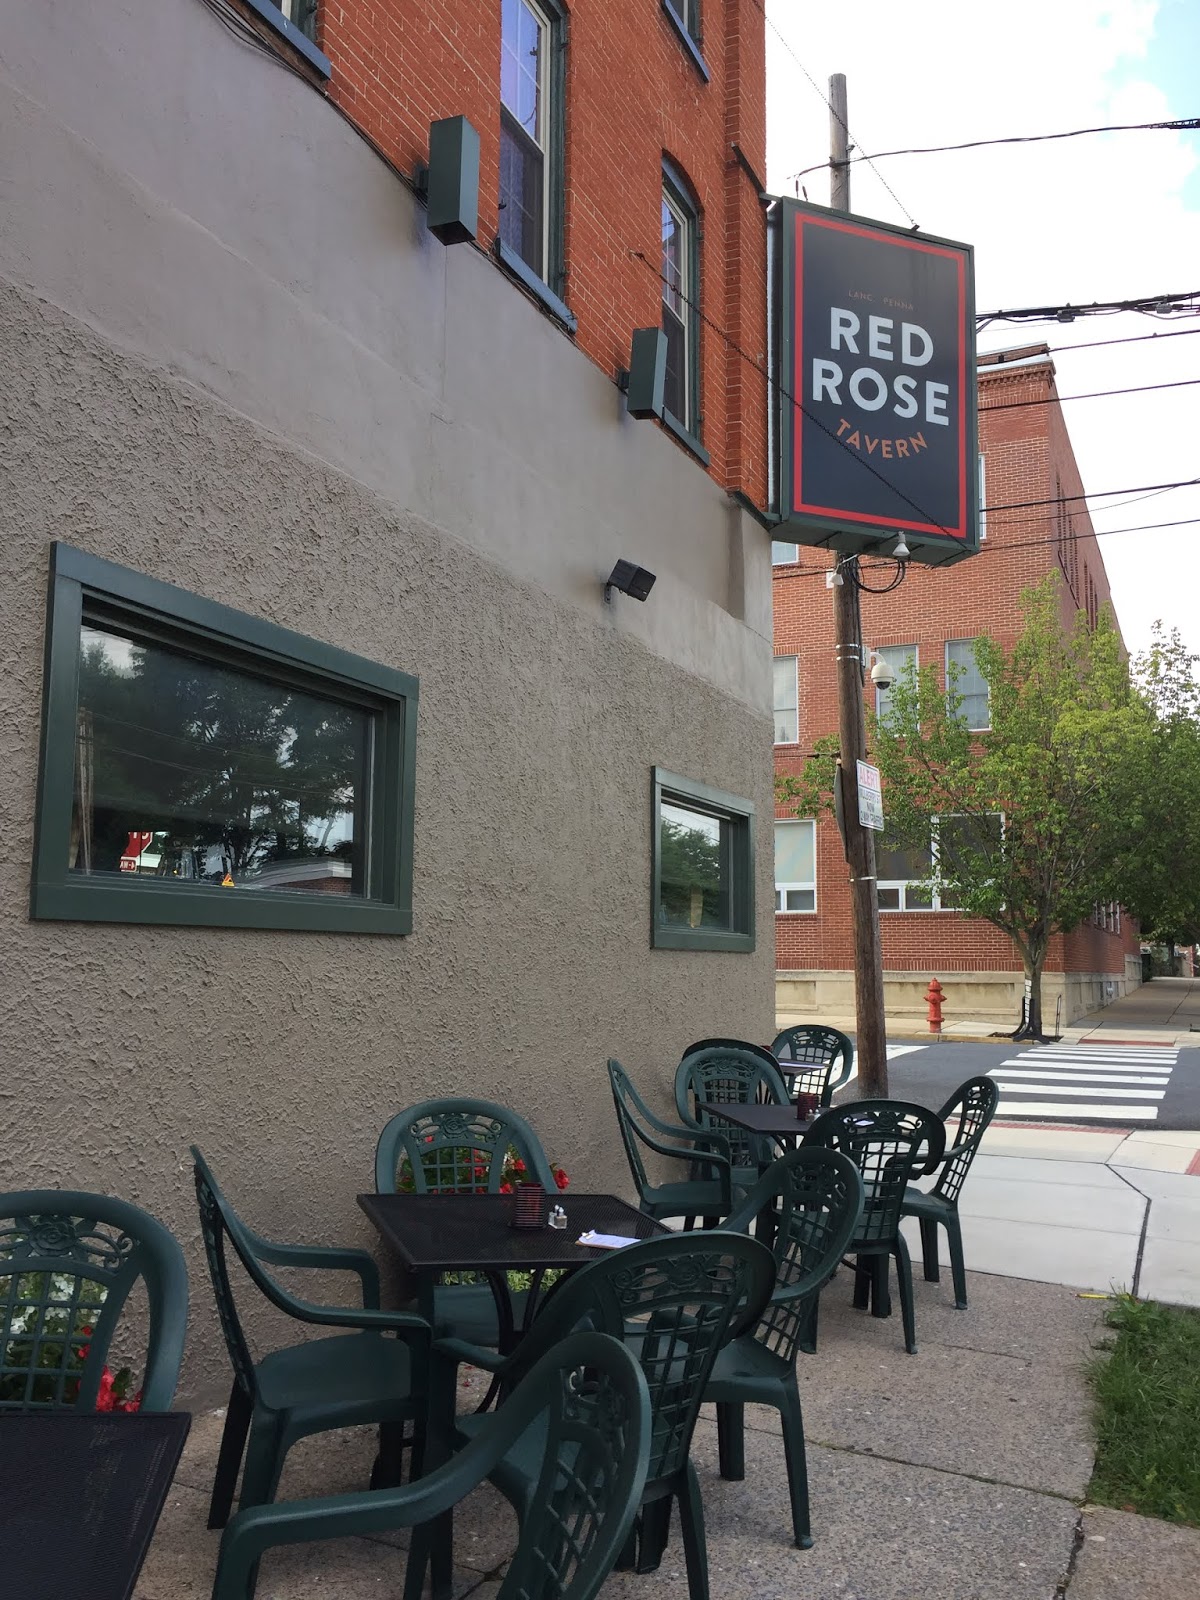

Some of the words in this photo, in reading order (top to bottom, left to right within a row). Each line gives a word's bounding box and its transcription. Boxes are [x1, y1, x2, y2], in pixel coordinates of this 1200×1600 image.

[830, 306, 934, 367] RED
[812, 357, 949, 426] ROSE
[836, 418, 928, 459] TAVERN
[859, 765, 878, 789] ALERT
